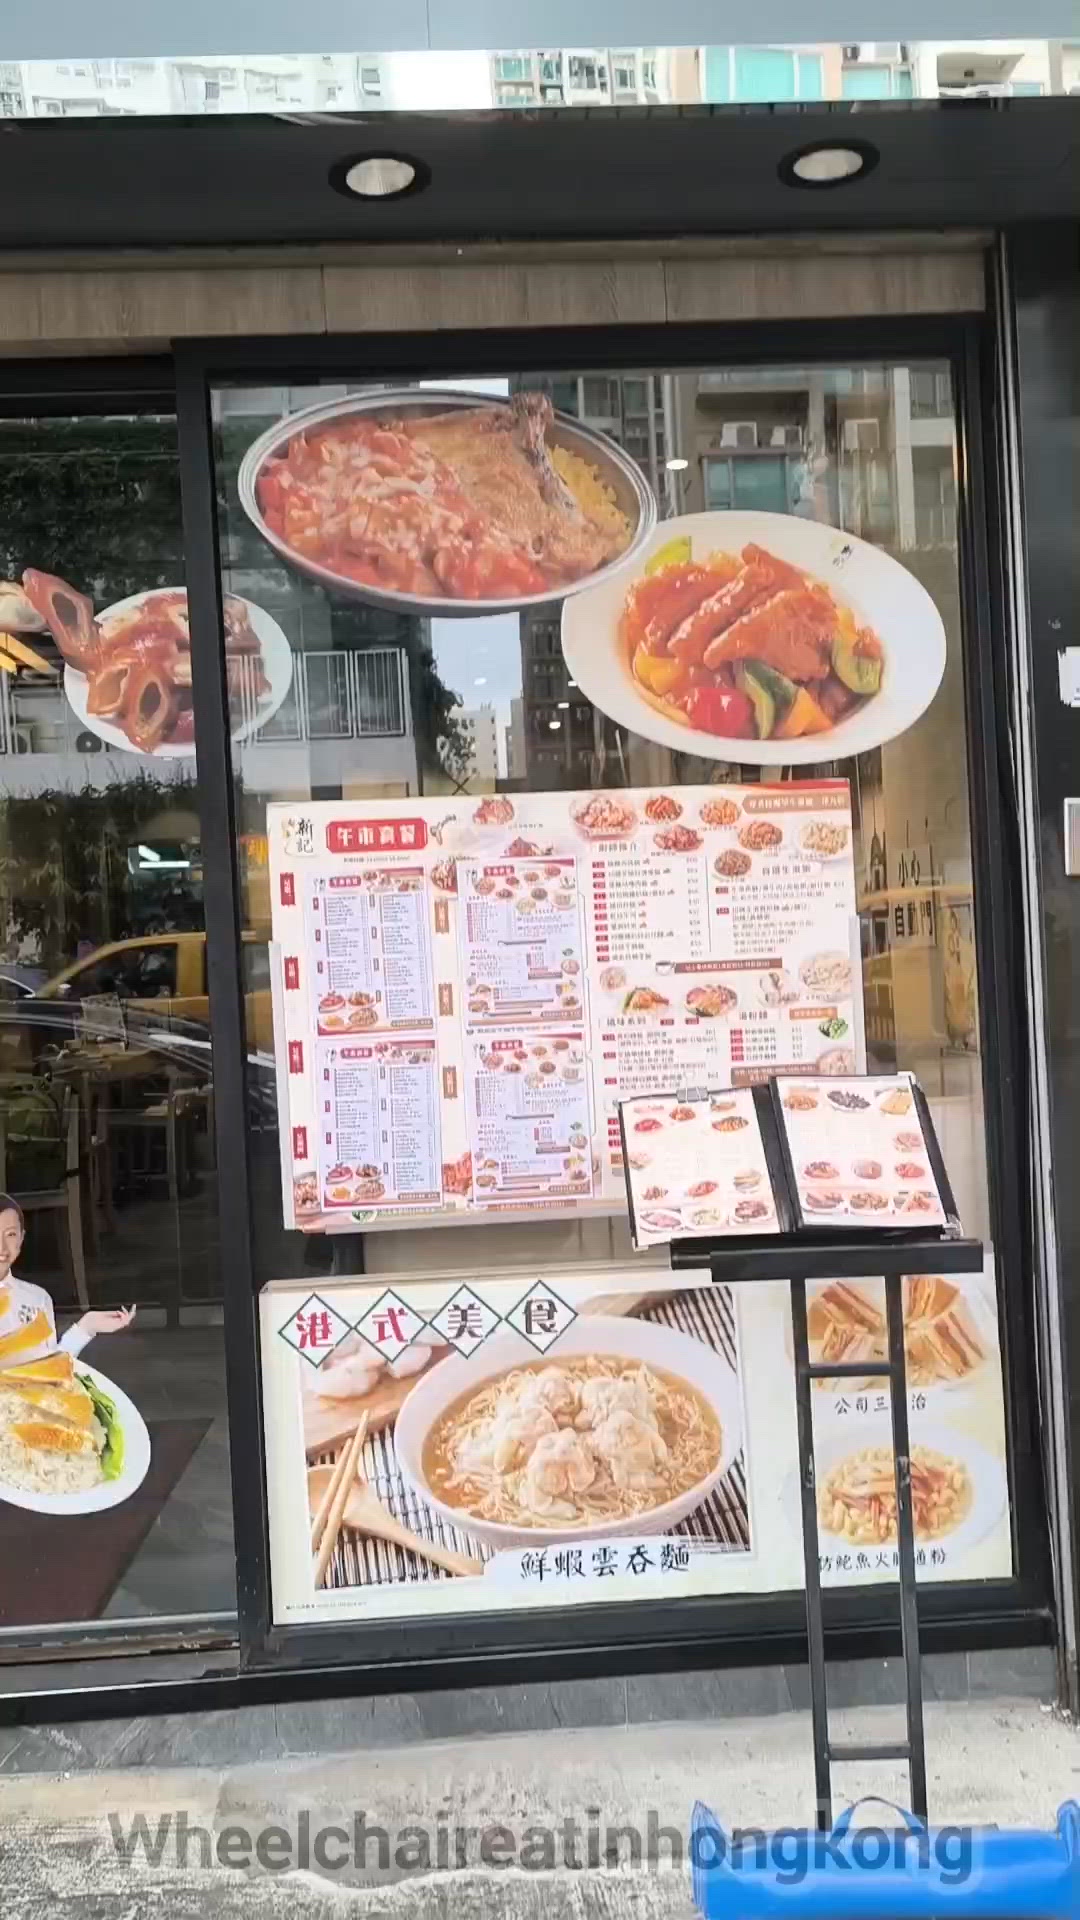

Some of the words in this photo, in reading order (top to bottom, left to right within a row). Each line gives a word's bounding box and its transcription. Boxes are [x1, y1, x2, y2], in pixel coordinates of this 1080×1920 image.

[295, 1298, 558, 1350] 港式美食
[834, 1392, 927, 1415] 公司三治
[520, 1542, 690, 1582] 鮮蝦雲吞麵
